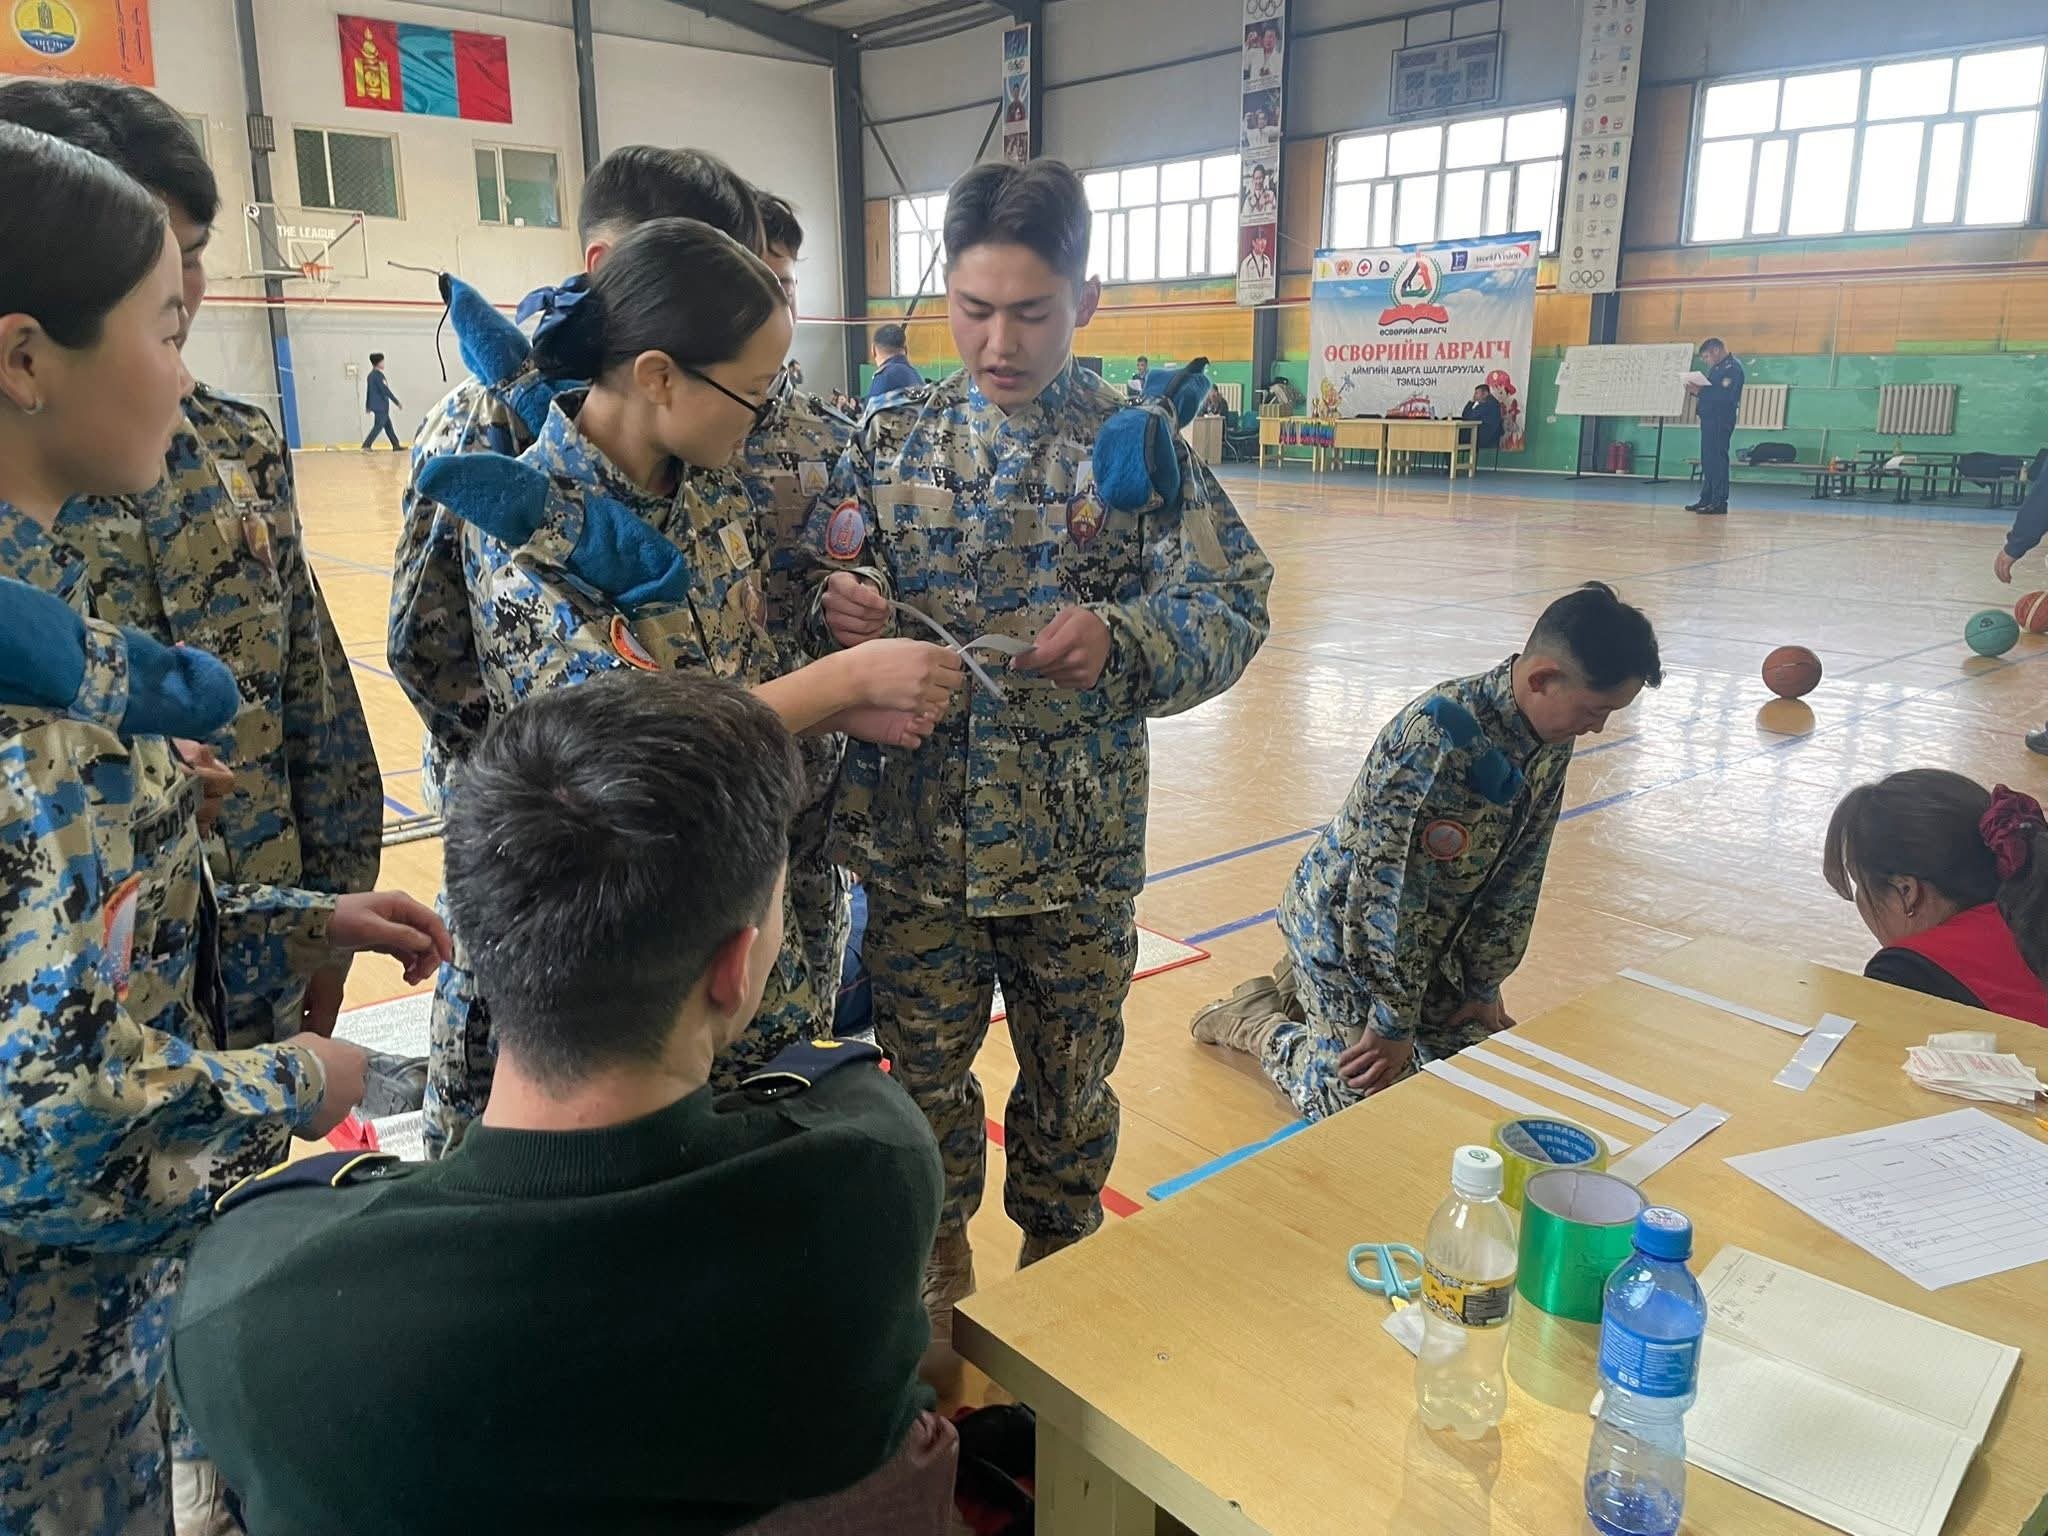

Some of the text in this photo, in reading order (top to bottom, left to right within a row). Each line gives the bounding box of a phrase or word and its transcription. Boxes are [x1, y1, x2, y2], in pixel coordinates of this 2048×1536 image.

[276, 225, 337, 240] THE LEAGUE
[1379, 326, 1447, 336] ӨСВӨРИЙН АВРАГЧ
[1323, 339, 1511, 362] ӨСВӨРИЙН АВРАГЧ
[1351, 365, 1485, 375] АЙМГИЙН АВАРГА ШАЛГАРУУЛАХ
[1396, 378, 1437, 387] ТЭМЦЭЭН
